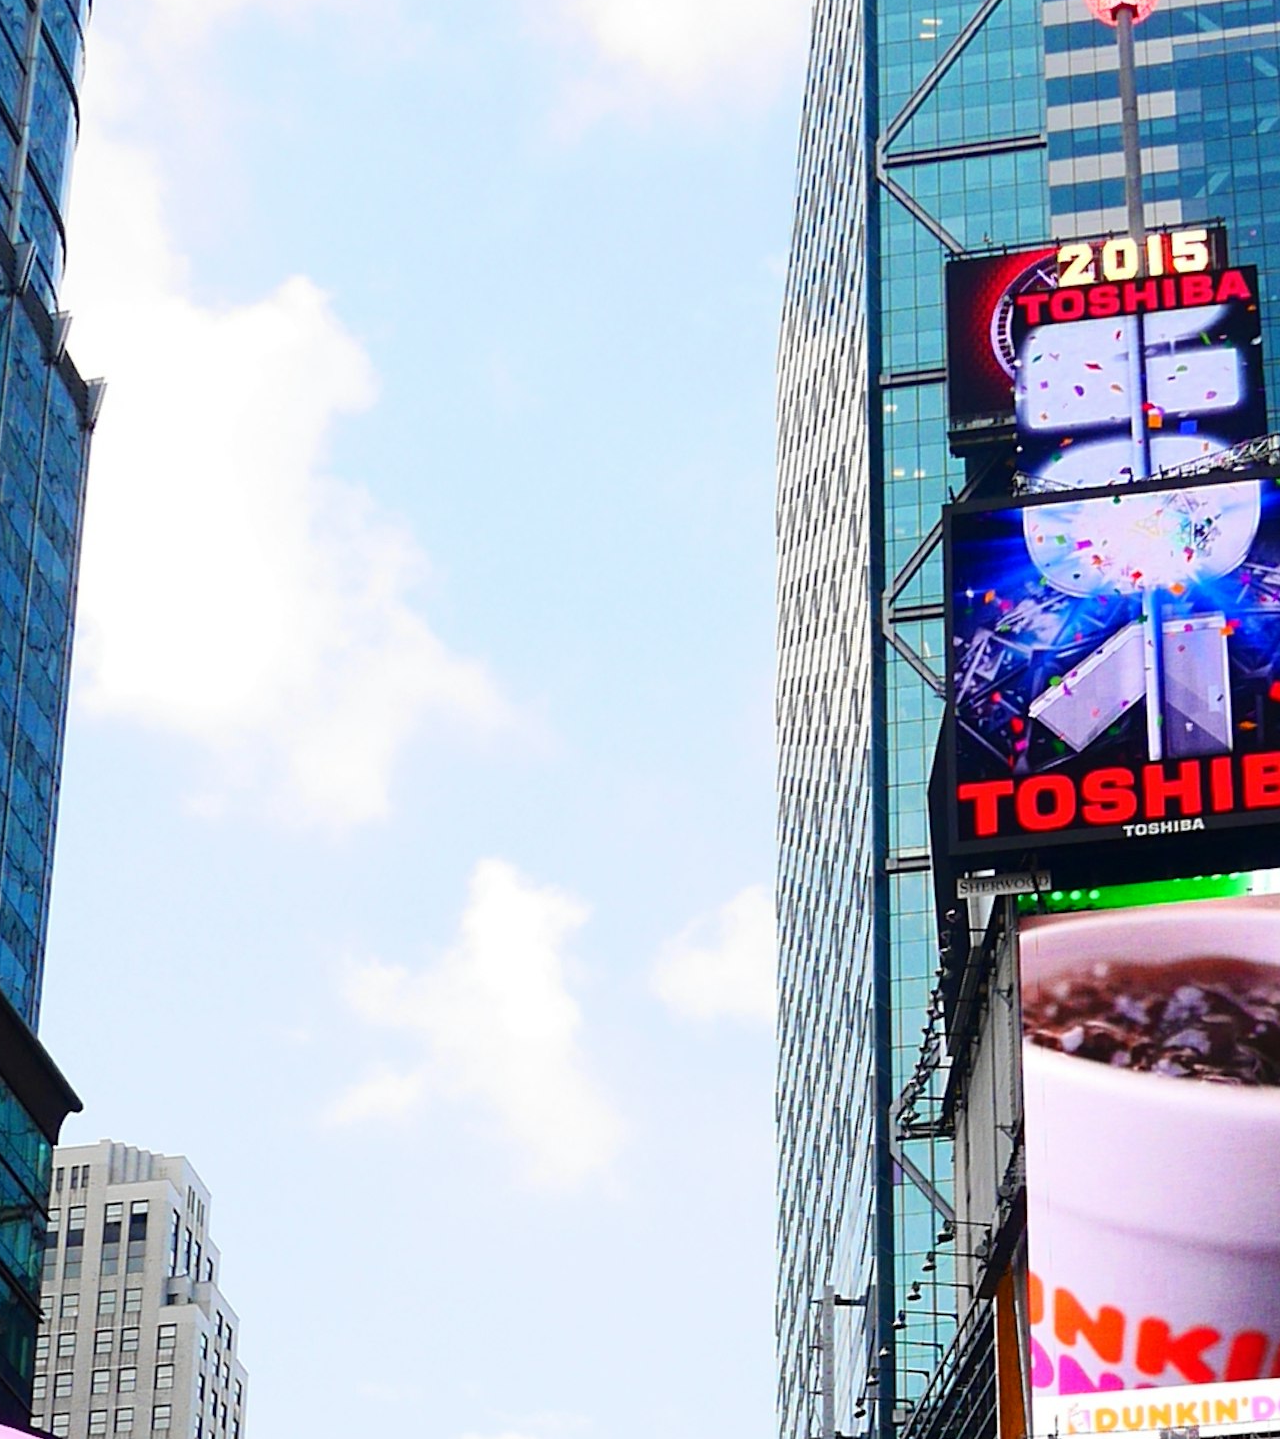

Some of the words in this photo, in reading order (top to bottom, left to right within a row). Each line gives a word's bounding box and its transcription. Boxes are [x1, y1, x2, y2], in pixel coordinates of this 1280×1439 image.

[1056, 230, 1211, 288] 2015
[1019, 267, 1252, 325] TOSHIBA
[1122, 816, 1206, 838] TOSHIBA
[959, 874, 1049, 895] SHERWOOD
